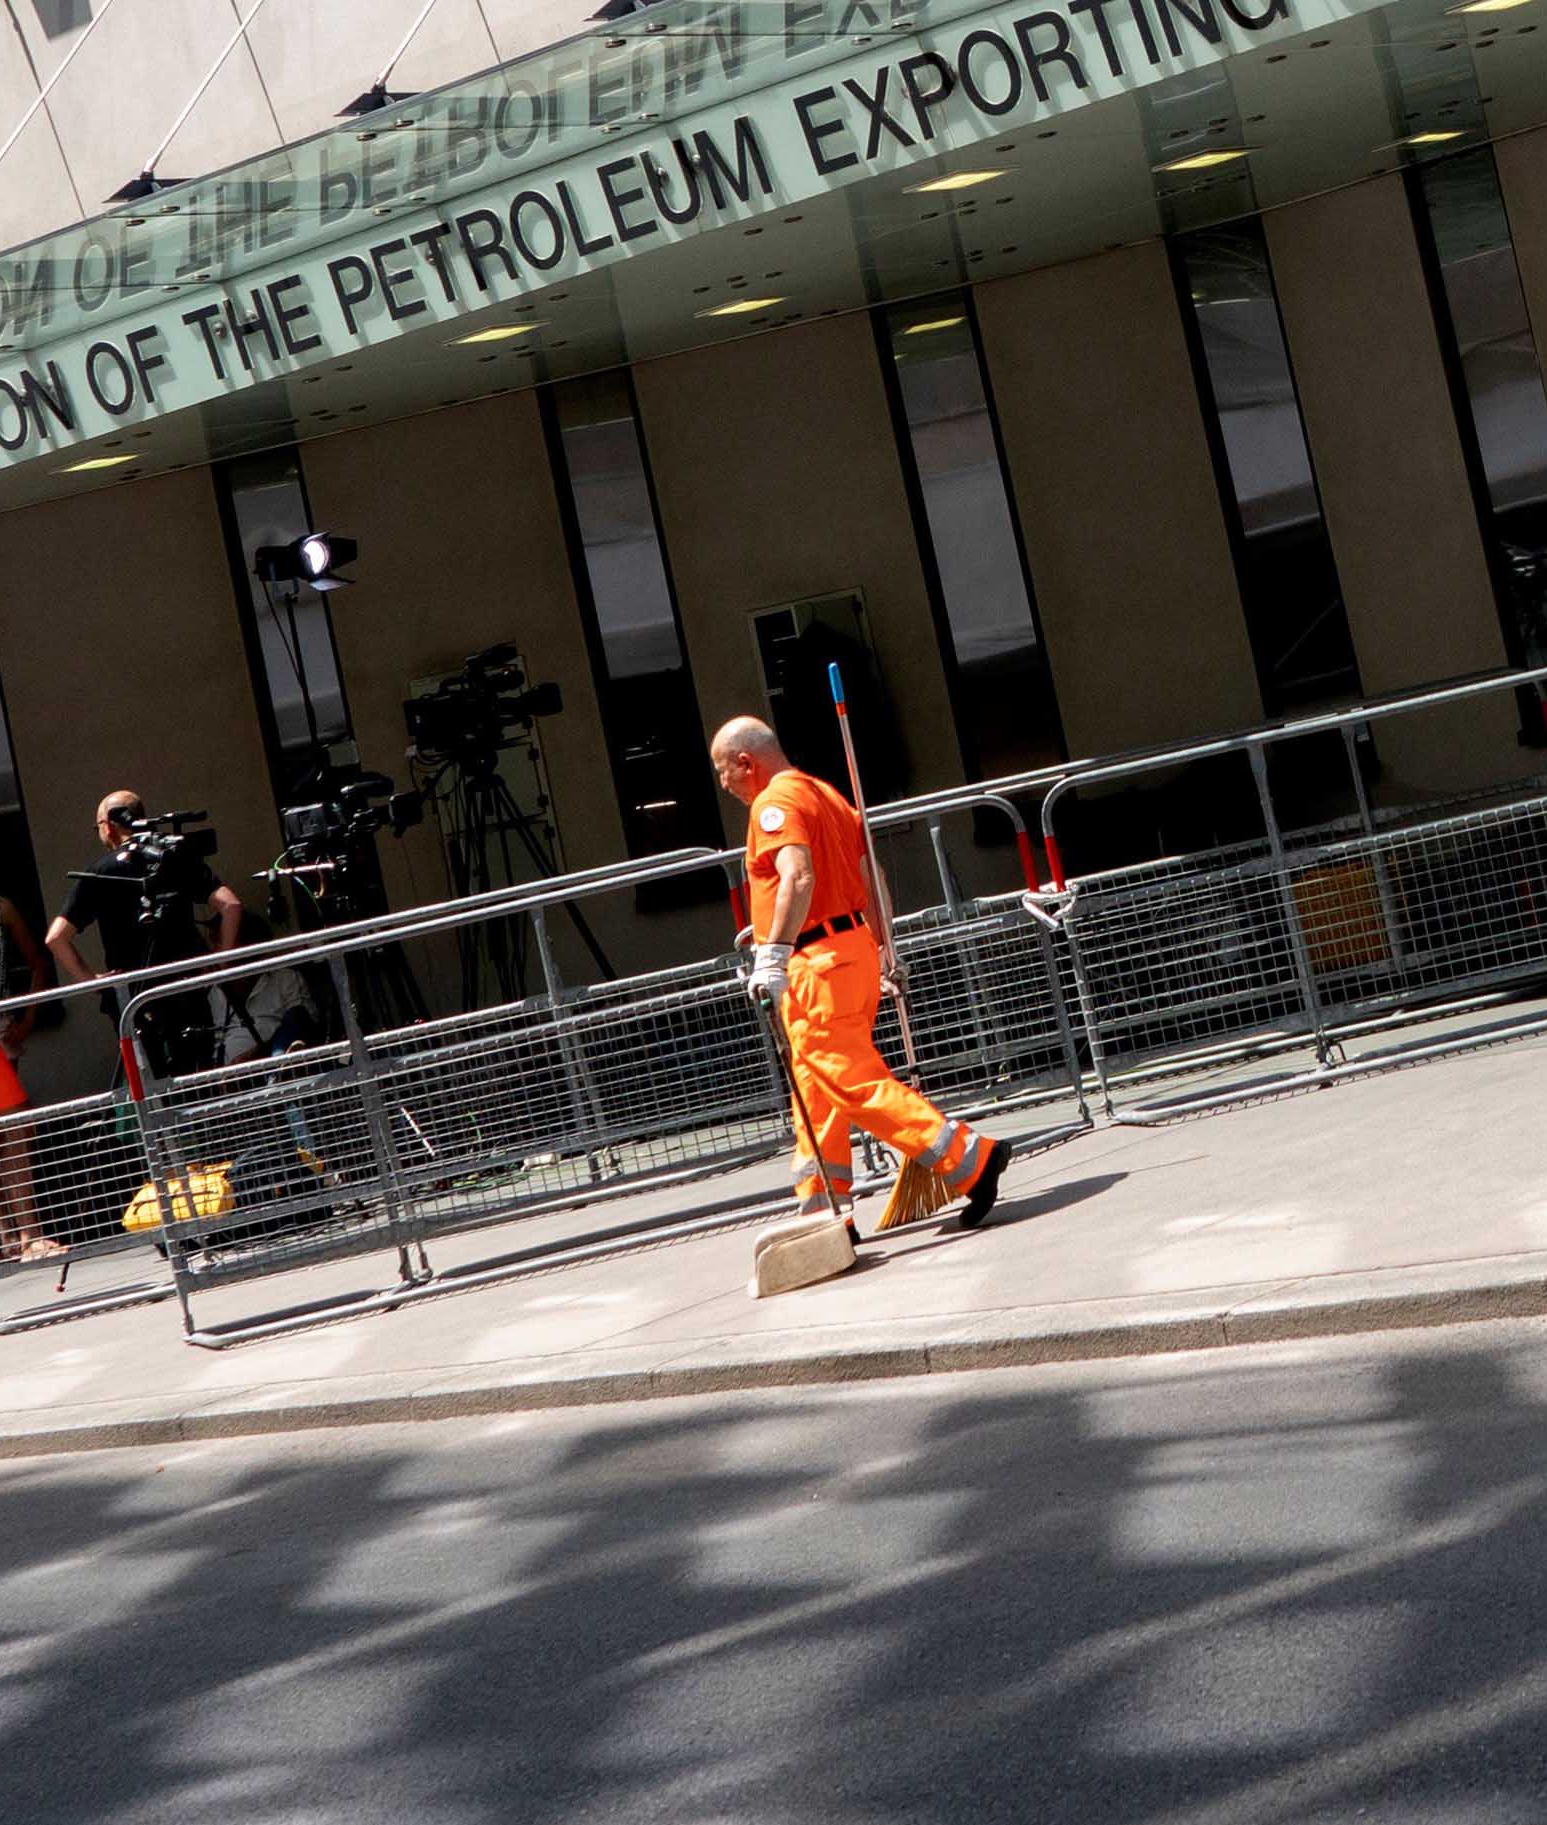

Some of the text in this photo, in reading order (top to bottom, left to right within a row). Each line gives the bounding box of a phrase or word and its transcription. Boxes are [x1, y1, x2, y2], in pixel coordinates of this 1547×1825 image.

[86, 325, 165, 415] OF
[182, 275, 323, 379] THE
[327, 116, 774, 335] PETROLEUM
